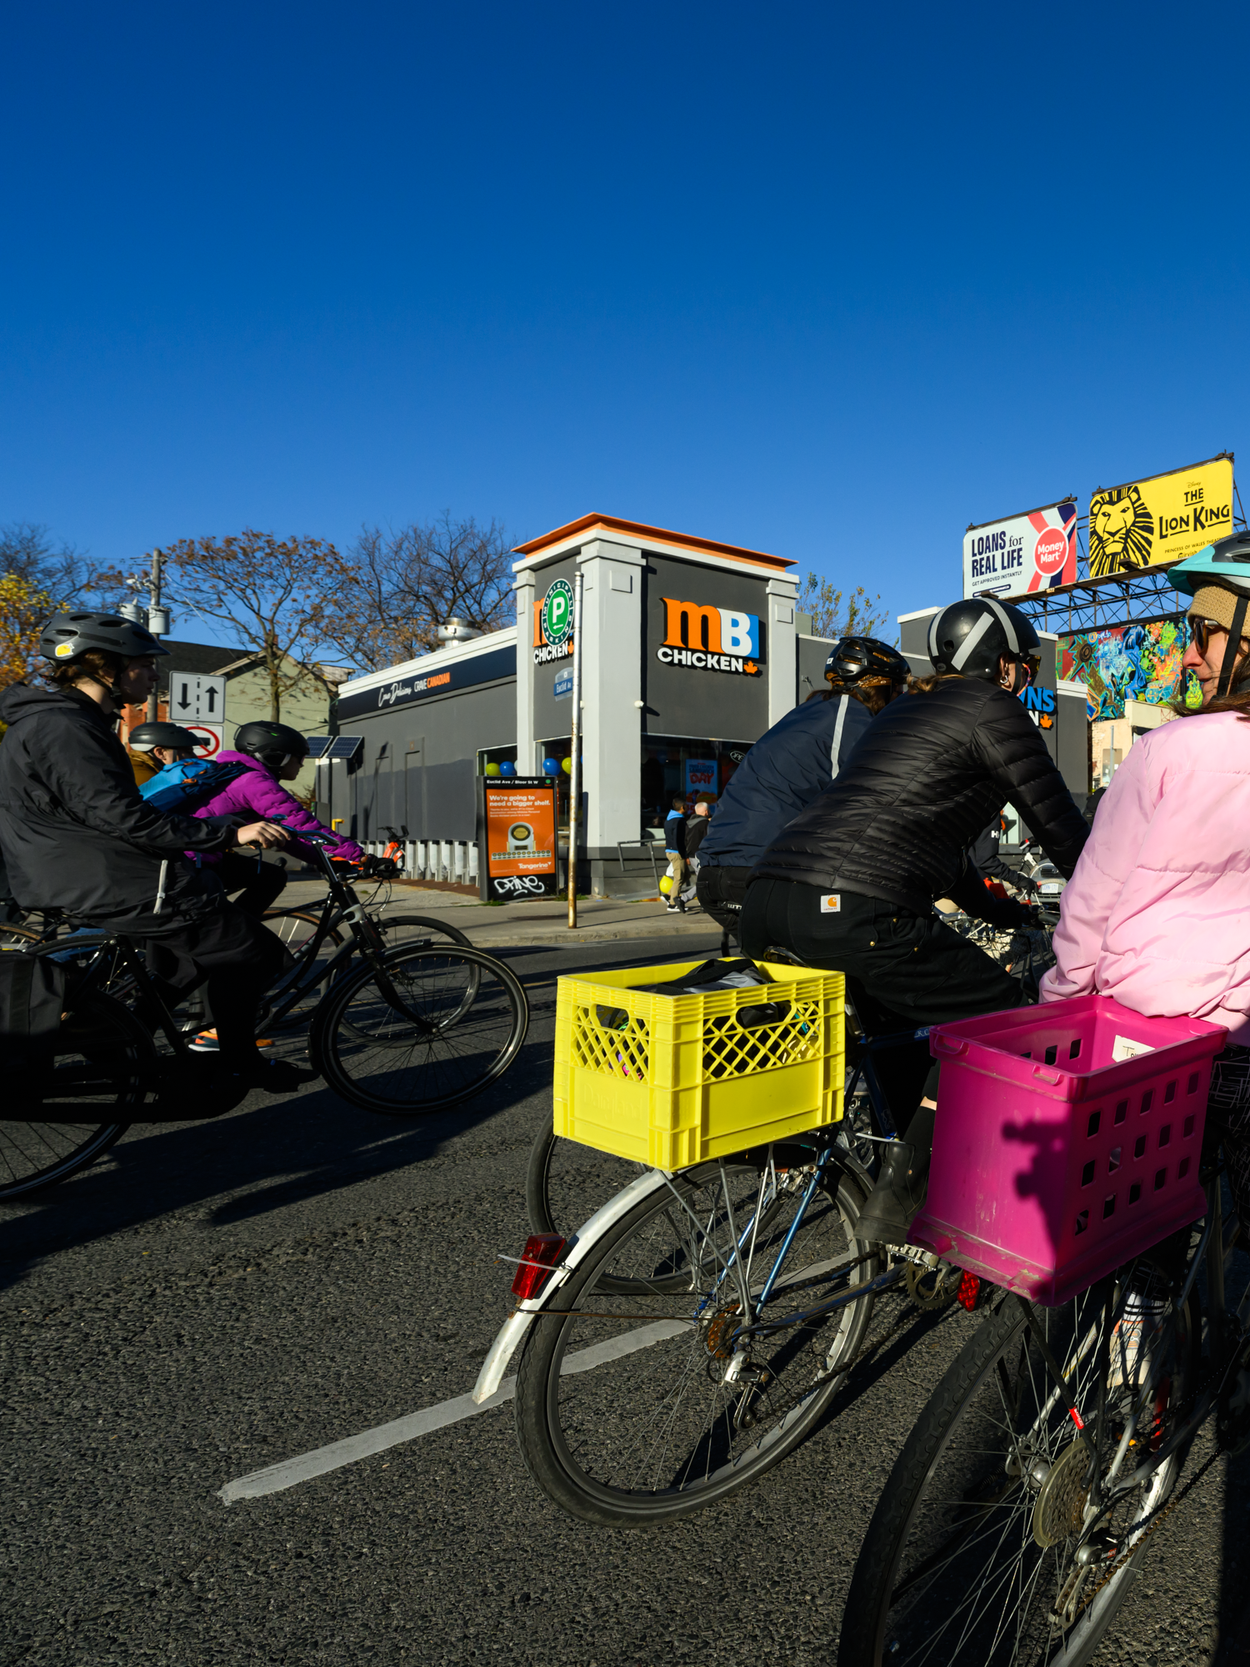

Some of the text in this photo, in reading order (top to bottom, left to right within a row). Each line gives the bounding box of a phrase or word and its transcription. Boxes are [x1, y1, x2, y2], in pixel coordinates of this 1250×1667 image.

[1184, 488, 1204, 503] THE
[1159, 504, 1229, 540] LION KING
[972, 531, 1024, 557] LOANS for
[1037, 541, 1064, 555] Money
[972, 547, 1023, 578] REAL LIFE
[1040, 552, 1059, 564] Mart
[980, 576, 1000, 584] APPROVED
[1001, 570, 1022, 579] INSTANTLY
[553, 597, 565, 624] P
[534, 640, 568, 664] CHICKEN
[657, 647, 743, 672] CHICKEN
[690, 772, 714, 784] DAY
[518, 862, 549, 870] Tangerine
